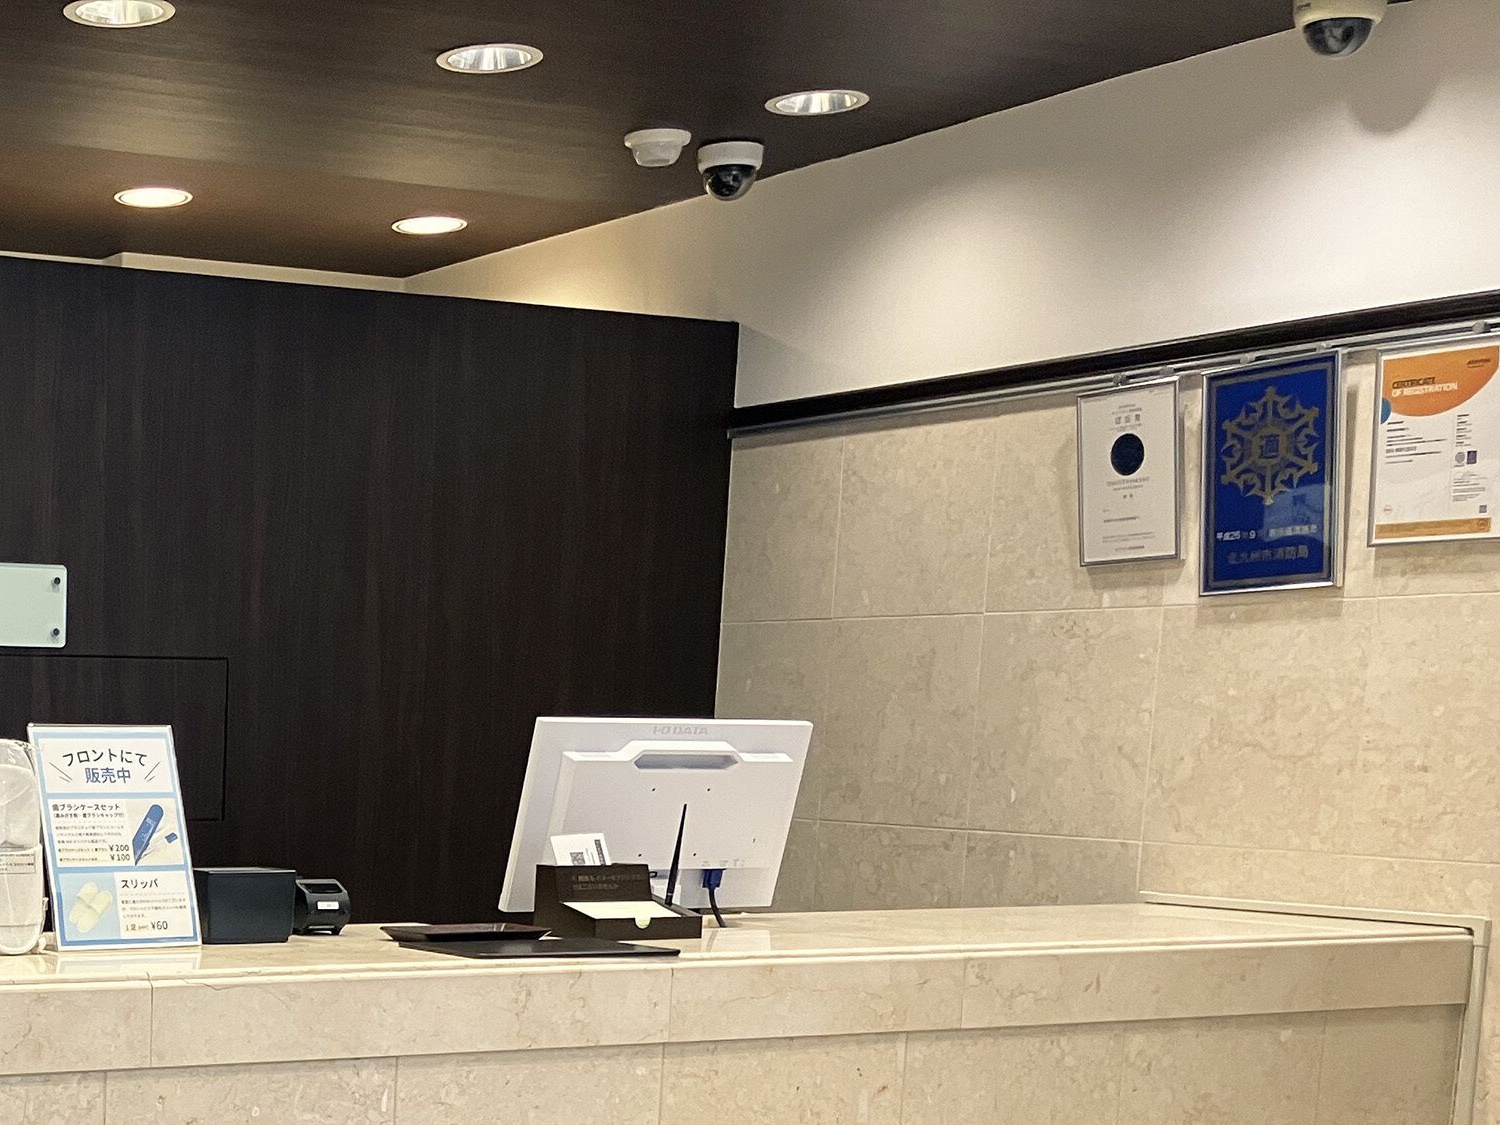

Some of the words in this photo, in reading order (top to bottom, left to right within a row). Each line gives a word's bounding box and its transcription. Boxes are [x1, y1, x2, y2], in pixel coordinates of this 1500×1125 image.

[62, 748, 148, 767] フロントにて
[85, 767, 132, 784] 販売中
[121, 878, 159, 889] スリッパ
